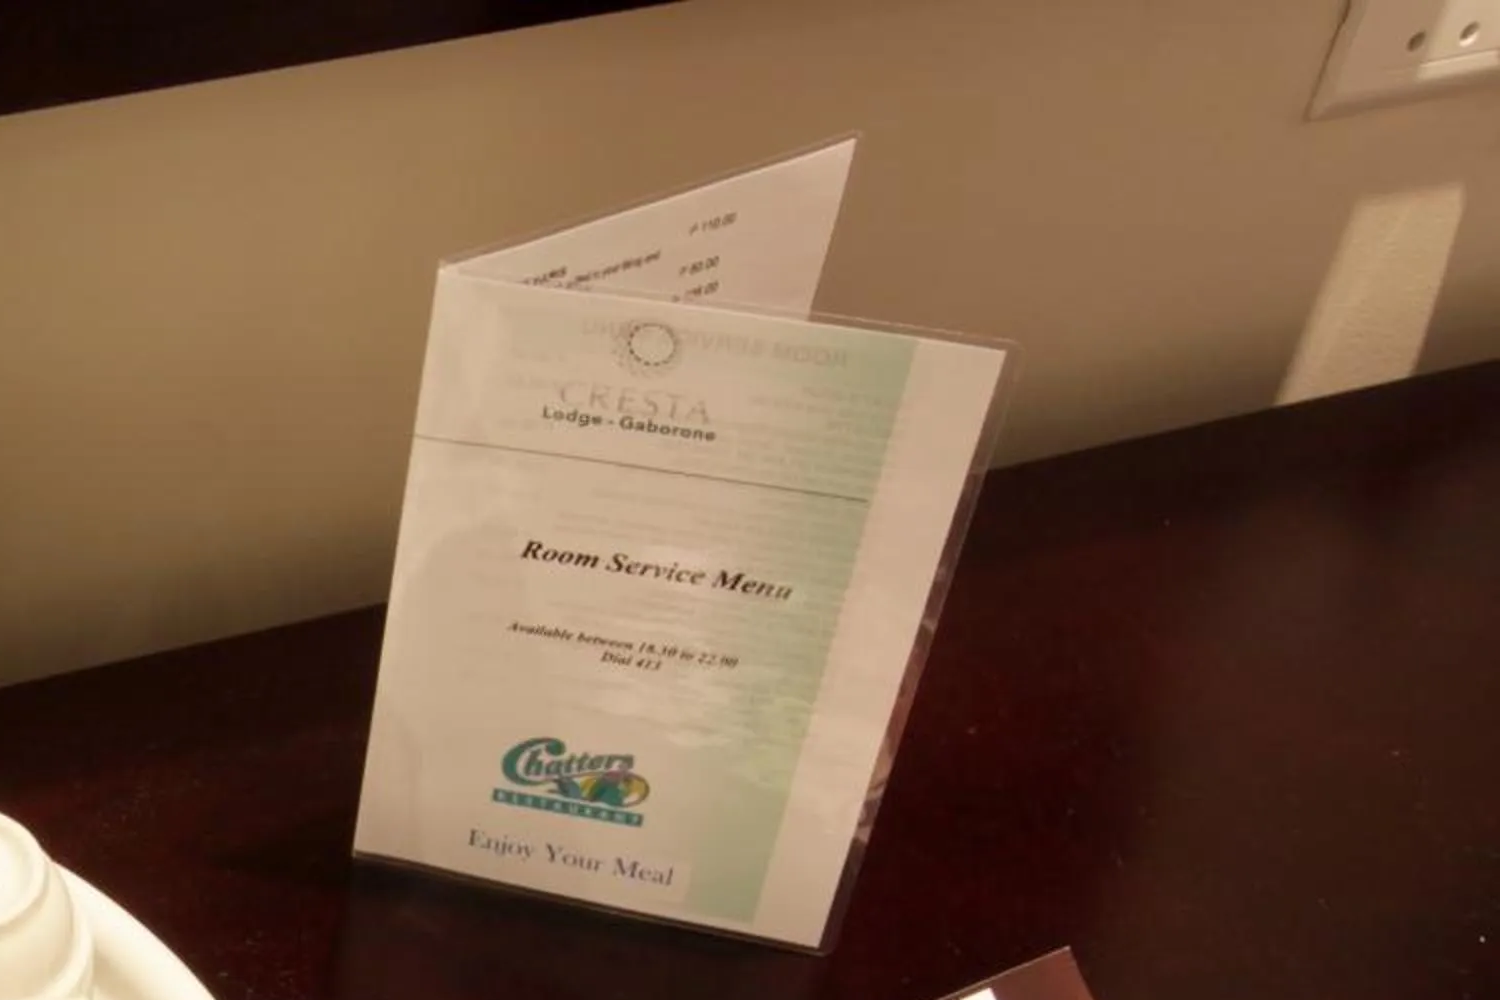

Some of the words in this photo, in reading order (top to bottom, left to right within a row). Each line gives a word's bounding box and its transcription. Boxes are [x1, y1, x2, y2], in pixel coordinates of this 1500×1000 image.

[542, 406, 603, 432] Lodge
[619, 416, 717, 443] Gaborone
[559, 380, 712, 425] CRESTA
[520, 540, 600, 571] Room
[605, 552, 706, 588] Service
[711, 571, 794, 602] Menu
[506, 620, 573, 642] Available
[577, 631, 634, 651] between
[600, 650, 632, 667] Dial
[501, 736, 635, 787] Chatters
[467, 828, 534, 862] Enjoy
[546, 842, 604, 873] Your
[612, 856, 675, 887] Meal
